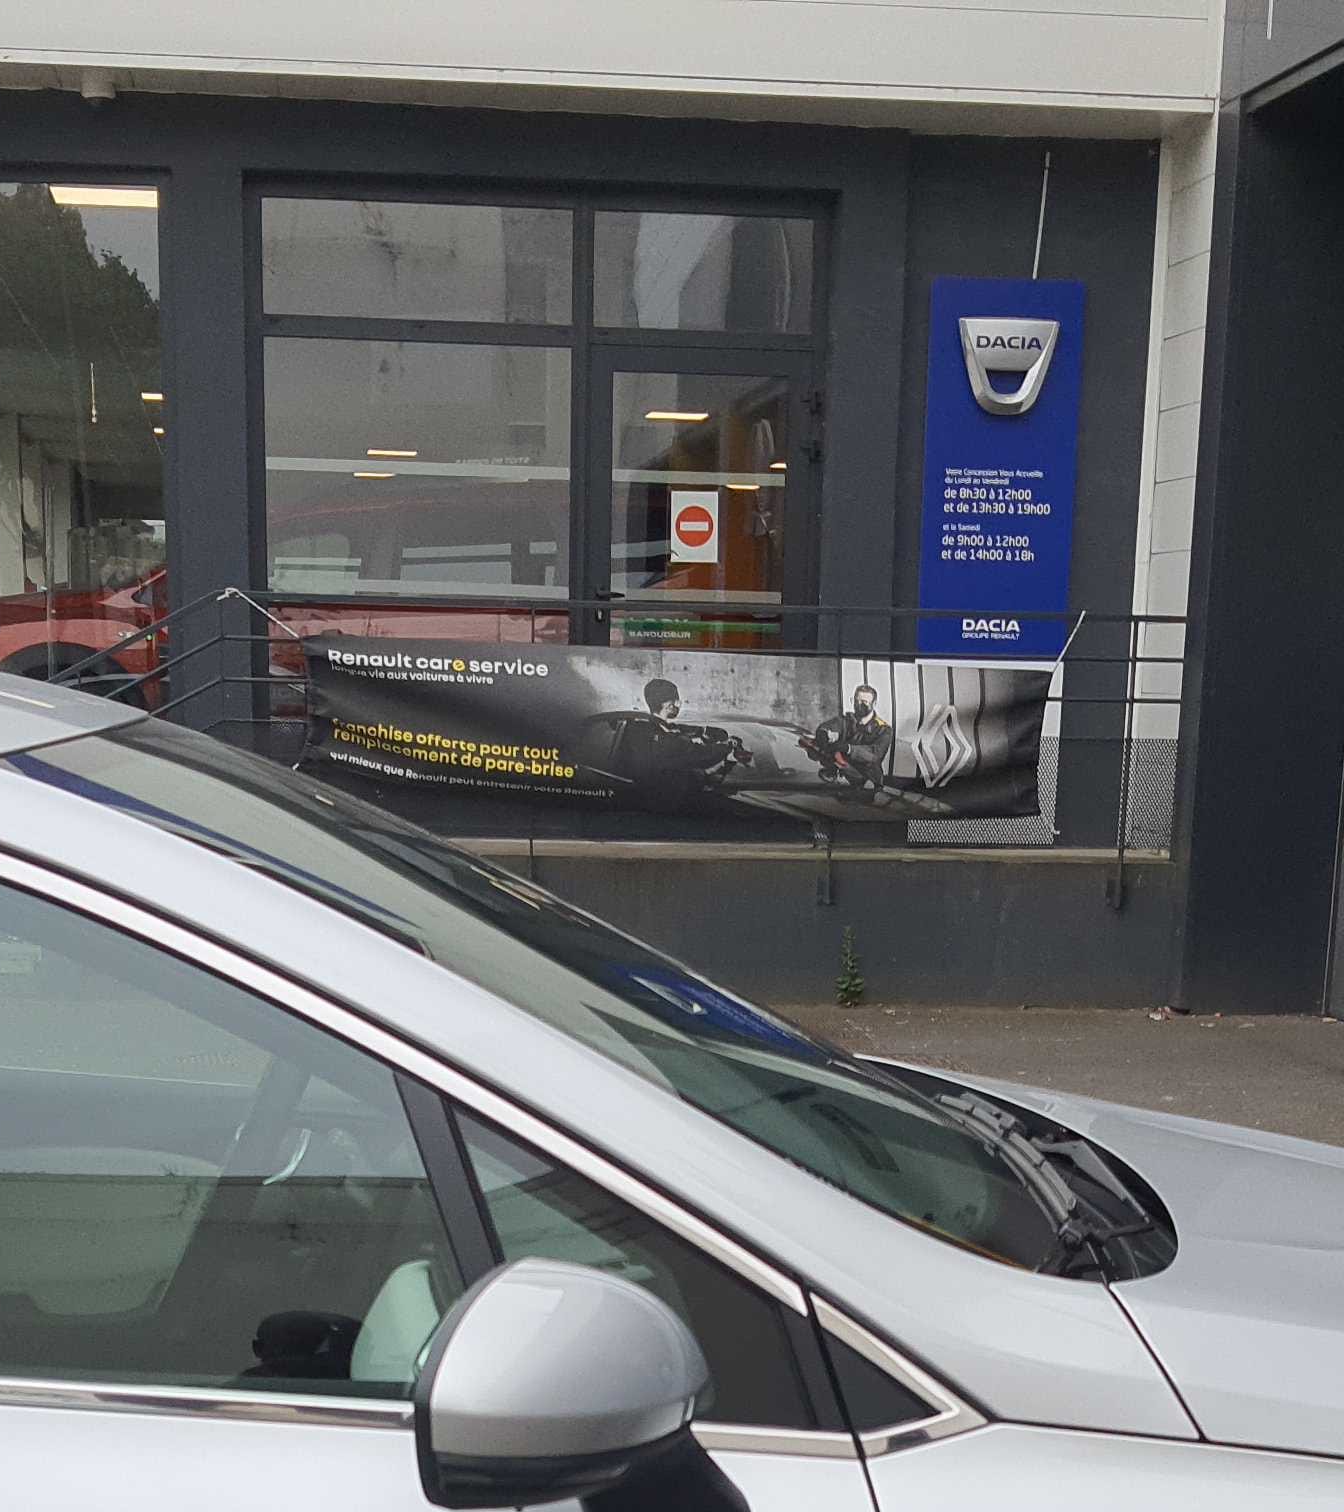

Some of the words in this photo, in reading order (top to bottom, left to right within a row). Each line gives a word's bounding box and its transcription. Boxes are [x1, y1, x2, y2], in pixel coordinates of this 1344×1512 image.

[976, 335, 1042, 350] DACIA
[944, 487, 956, 499] de
[959, 487, 986, 499] 8h30
[989, 488, 995, 500] à
[997, 488, 1032, 500] 12h00
[944, 502, 954, 513] et
[956, 502, 969, 513] de
[972, 502, 1005, 514] 13h30
[1008, 502, 1014, 514] à
[1017, 502, 1050, 515] 19h00
[942, 534, 954, 546] de
[957, 535, 984, 546] 9h00
[987, 535, 992, 547] à
[995, 535, 1029, 547] 12h00
[941, 549, 951, 560] et
[954, 549, 967, 560] de
[969, 549, 1003, 561] 14h00
[1006, 549, 1011, 561] à
[1014, 550, 1034, 561] 18h
[962, 618, 1020, 632] DACIA
[327, 648, 411, 669] Renault
[416, 656, 466, 672] care
[469, 658, 549, 677] service
[368, 667, 385, 680] vie
[387, 671, 407, 680] aux
[409, 671, 455, 682] voitures
[456, 670, 465, 682] à
[466, 673, 494, 685] vivre
[333, 728, 457, 765] remplacement
[460, 751, 482, 768] de
[416, 732, 477, 752] offerte
[479, 742, 519, 760] pour
[522, 745, 560, 761] tout
[348, 756, 382, 772] mieux
[383, 763, 404, 777] que
[406, 767, 448, 784] Renault
[449, 775, 475, 787] peut
